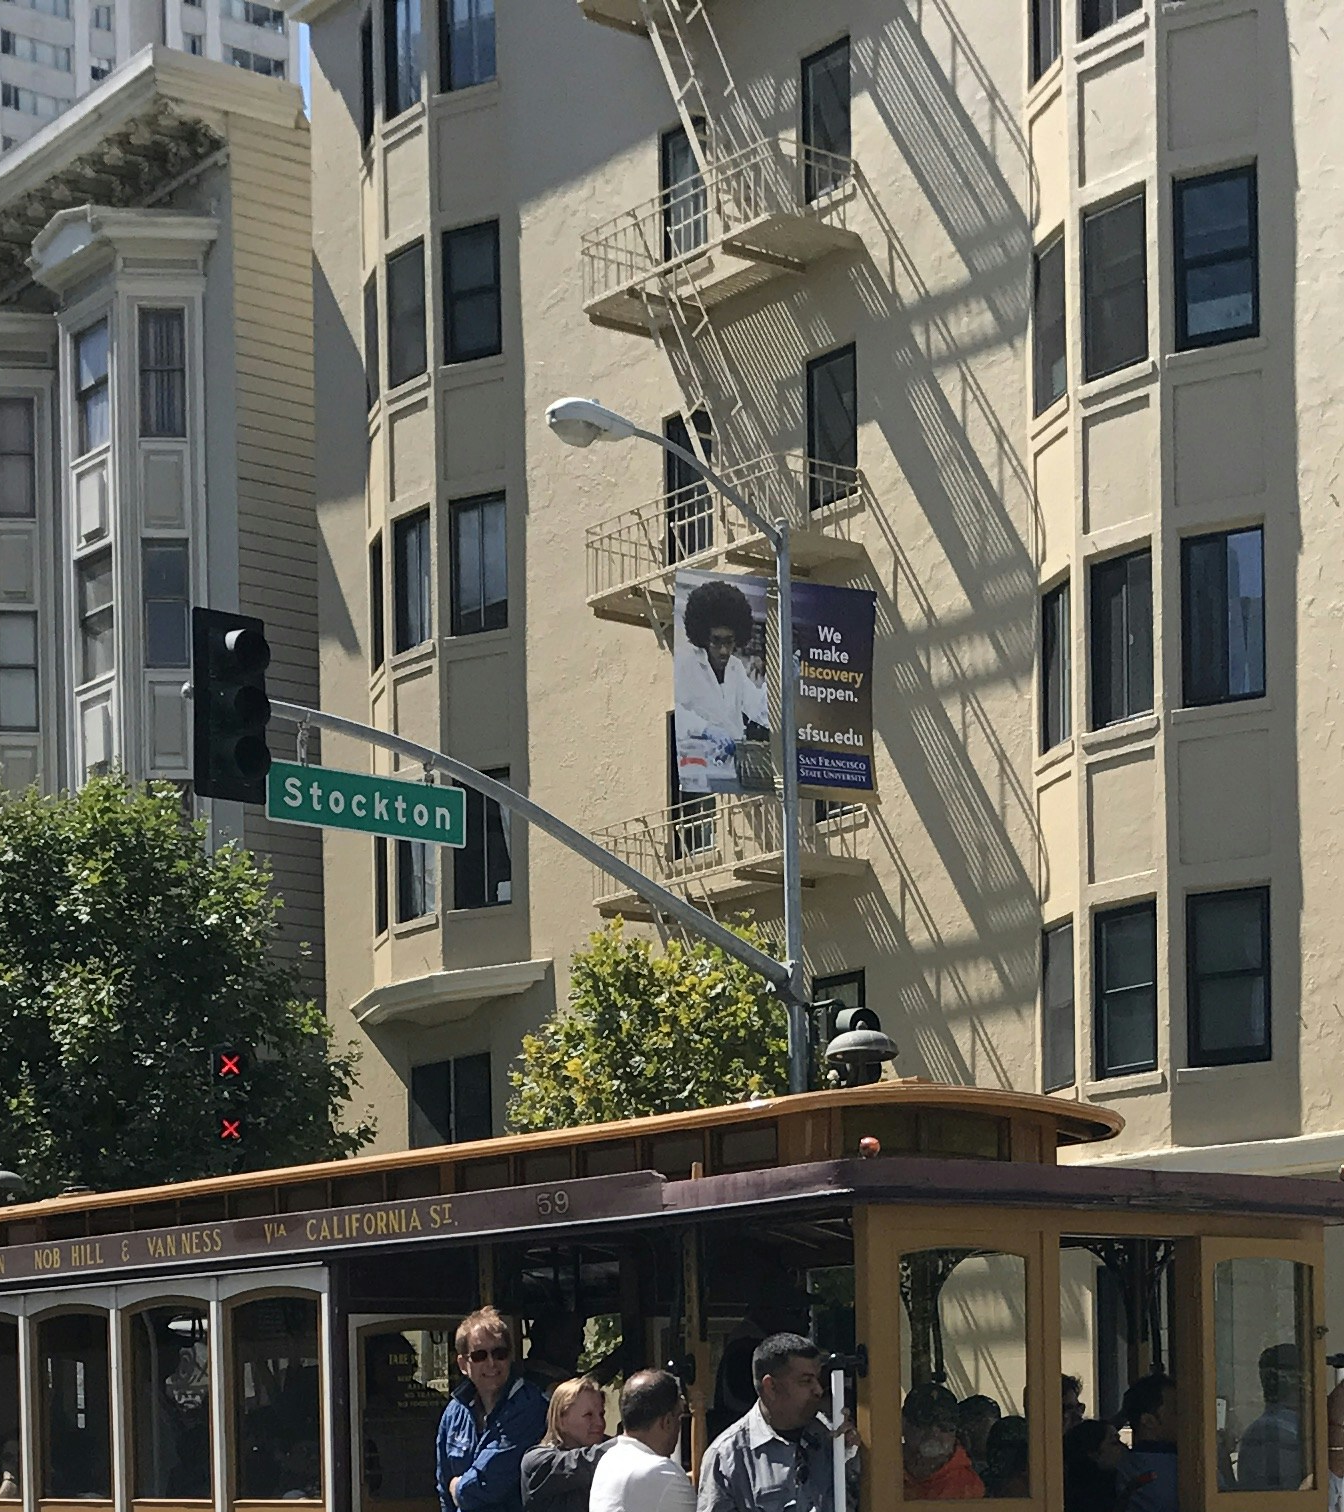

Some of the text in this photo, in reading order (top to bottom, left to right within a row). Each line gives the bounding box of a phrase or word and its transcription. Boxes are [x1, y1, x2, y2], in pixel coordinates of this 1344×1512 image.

[818, 625, 842, 644] We
[809, 645, 849, 664] make
[799, 679, 858, 703] happen.
[798, 723, 864, 747] sfsu.edu
[798, 754, 866, 770] SAN FRANCISCO
[283, 776, 451, 830] Stockton
[536, 1190, 570, 1215] 59
[34, 1248, 61, 1270] NOB
[71, 1243, 104, 1266] HILL
[146, 1234, 176, 1258] VAN
[181, 1228, 222, 1254] NESS
[306, 1207, 422, 1241] CALIFORNIA
